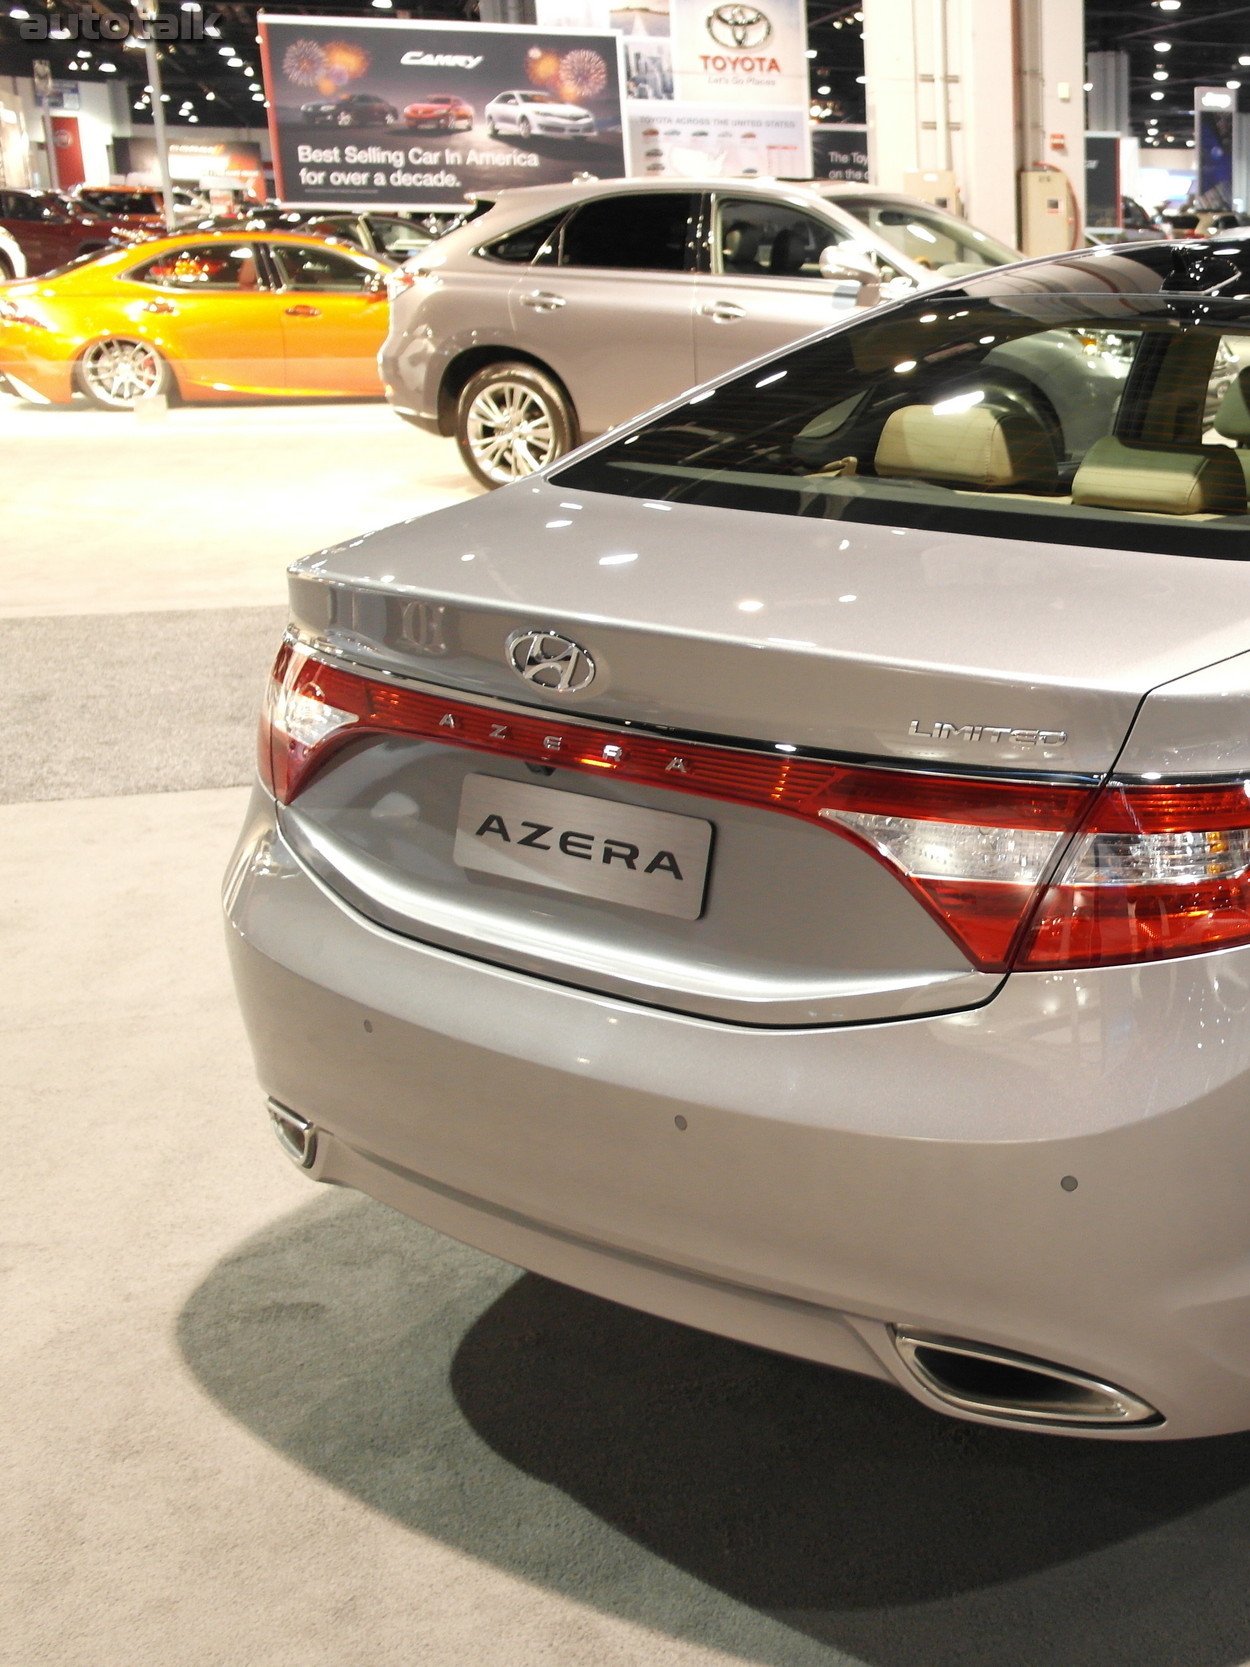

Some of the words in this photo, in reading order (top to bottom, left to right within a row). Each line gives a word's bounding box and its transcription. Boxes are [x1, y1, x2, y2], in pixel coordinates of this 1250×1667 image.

[700, 55, 781, 73] TOYOTA
[298, 145, 341, 164] Best
[344, 145, 405, 168] Selling
[409, 149, 439, 165] Car
[465, 150, 540, 168] America
[828, 151, 850, 164] The
[299, 168, 326, 186] for
[329, 171, 371, 186] over
[373, 173, 385, 186] a
[389, 170, 462, 187] decade.
[828, 170, 843, 180] on
[845, 168, 862, 180] the
[908, 720, 1067, 747] LIMITED
[475, 814, 683, 880] AZERA
